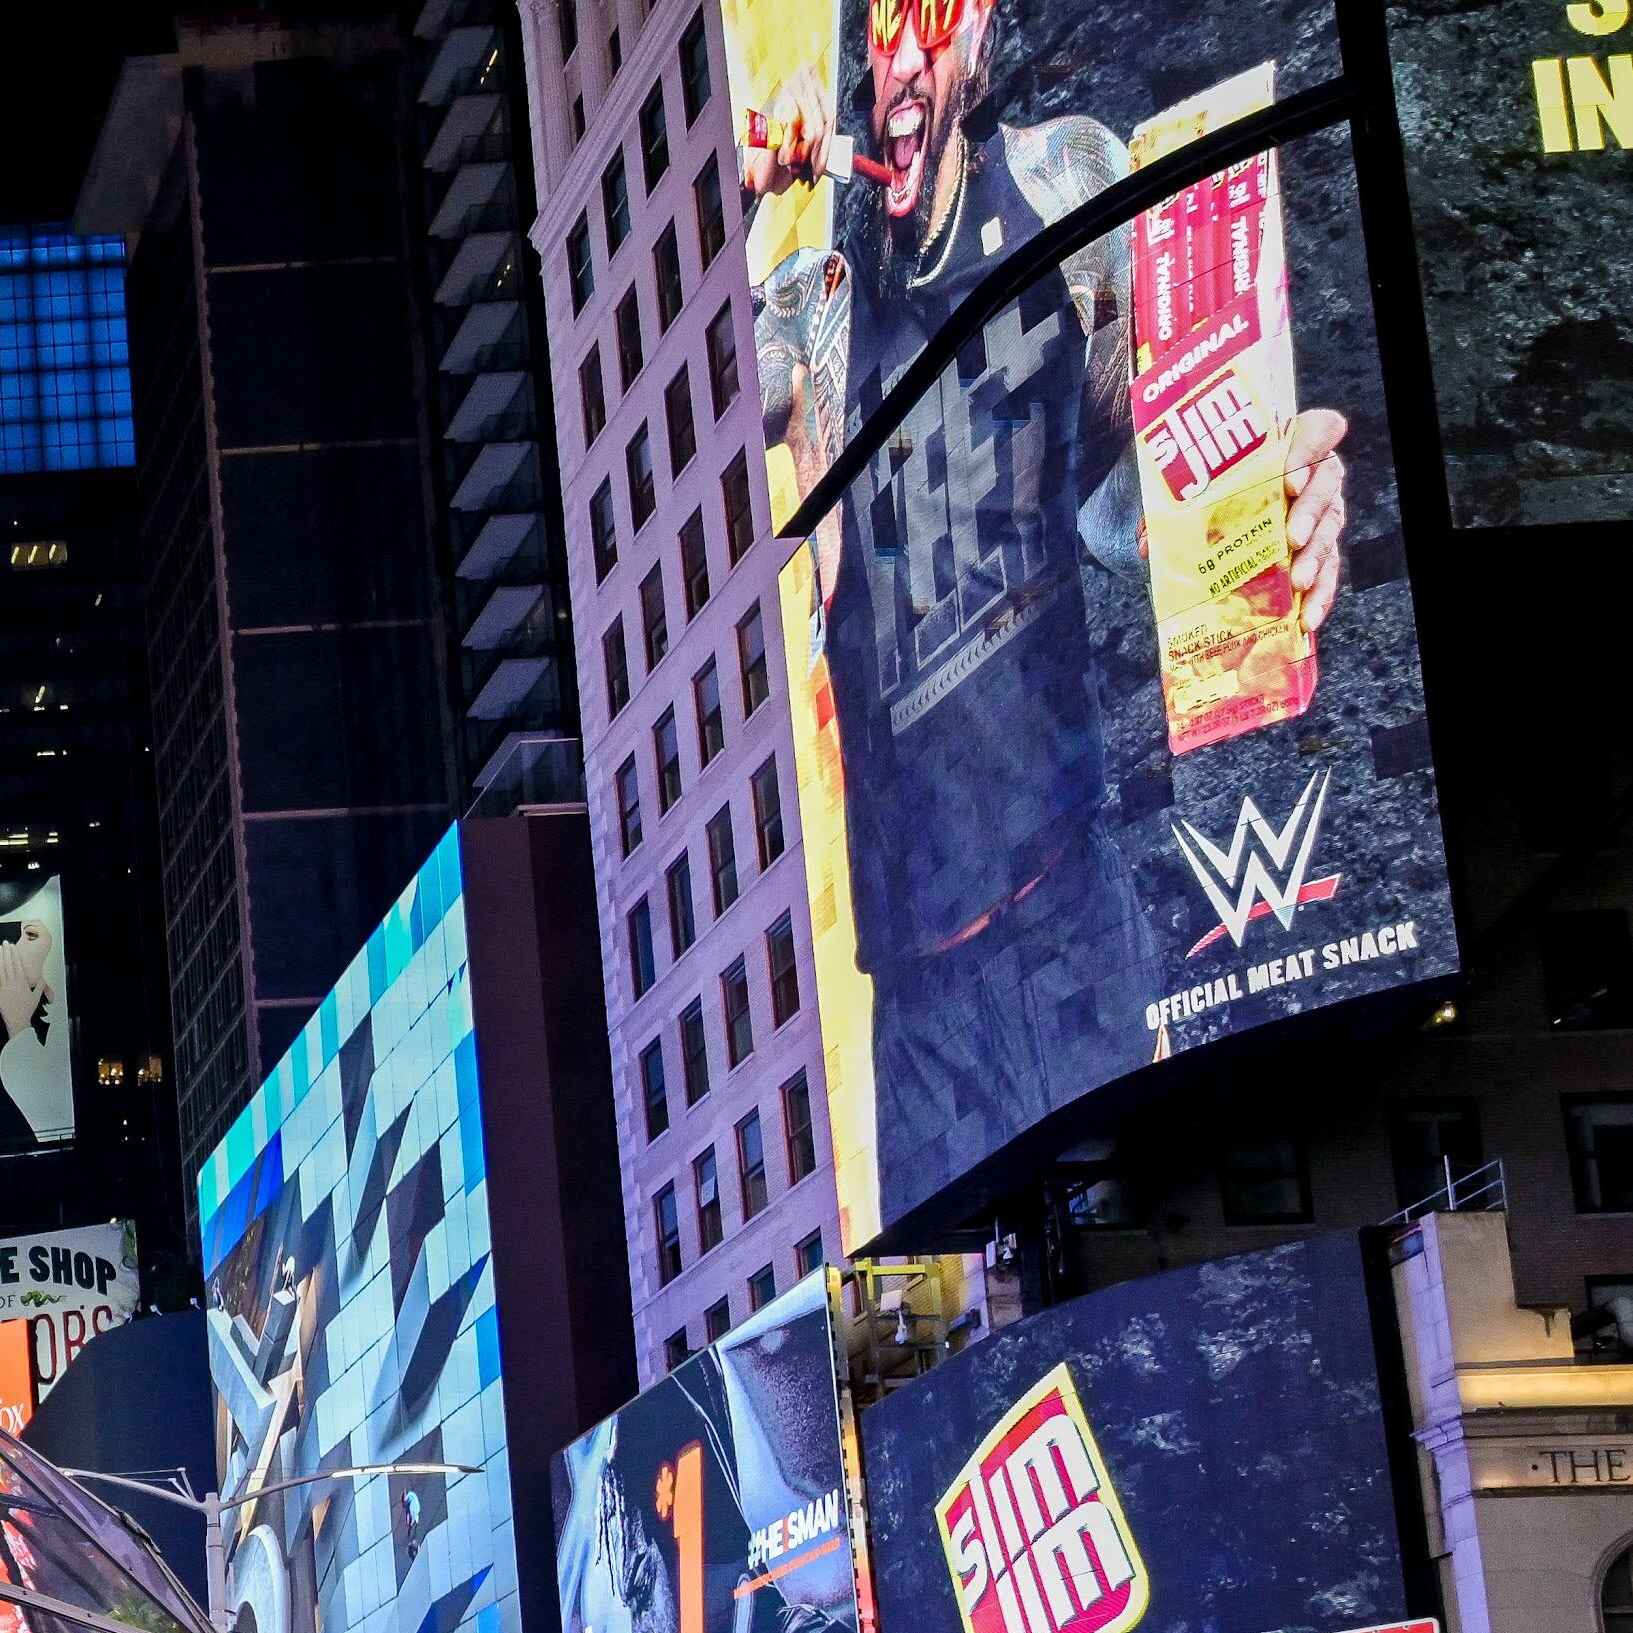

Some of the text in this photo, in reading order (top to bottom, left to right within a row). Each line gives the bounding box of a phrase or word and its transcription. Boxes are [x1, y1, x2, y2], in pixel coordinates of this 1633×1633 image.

[1142, 313, 1249, 404] ORIGINAL
[1146, 921, 1419, 1031] OFFICIAL MEAT SNACK
[27, 1245, 117, 1296] SHOP
[1539, 1449, 1632, 1484] THE
[747, 1487, 839, 1571] #HEISMAN
